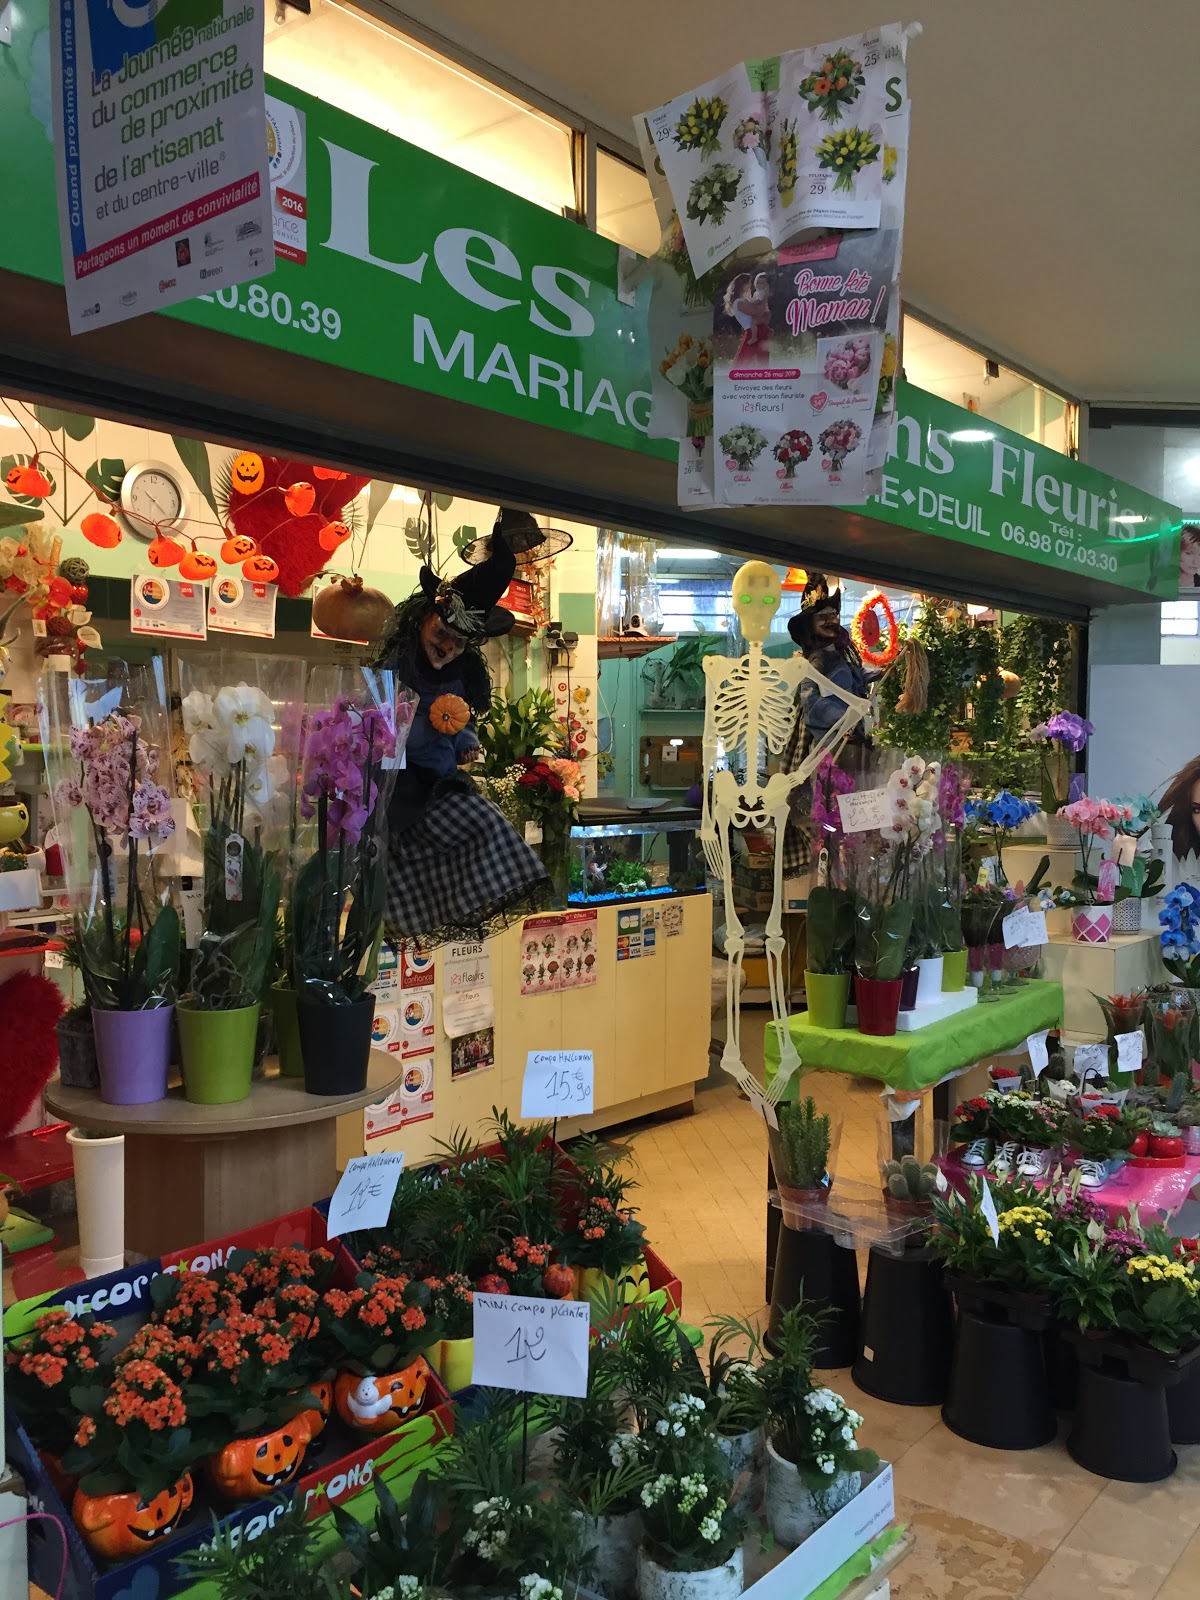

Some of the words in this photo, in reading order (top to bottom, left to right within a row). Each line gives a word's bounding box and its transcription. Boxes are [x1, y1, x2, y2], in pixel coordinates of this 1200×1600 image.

[63, 17, 73, 60] rime
[91, 69, 111, 97] La
[118, 26, 194, 84] Journée
[197, 5, 254, 45] nationale
[92, 100, 116, 129] du
[121, 44, 238, 115] commerce
[120, 115, 146, 145] de
[150, 62, 254, 138] proximité
[64, 67, 79, 157] proximité
[94, 164, 118, 194] de
[122, 116, 225, 182] l'artisanat
[68, 164, 81, 227] Quand
[96, 201, 110, 220] et
[112, 192, 129, 214] du
[281, 196, 304, 213] 2016
[76, 242, 125, 275] Partageons
[127, 236, 139, 250] un
[141, 216, 180, 243] moment
[181, 209, 195, 225] de
[196, 176, 259, 218] convivialité
[318, 136, 595, 338] Les
[794, 267, 842, 297] Bonne
[196, 284, 342, 340] 0.80.39
[785, 298, 872, 337] Maman
[733, 371, 763, 379] dimanche
[764, 370, 772, 378] 26
[773, 370, 783, 378] mai
[733, 384, 759, 392] Envoyez
[775, 383, 793, 391] fleurs
[757, 392, 780, 400] artisan
[780, 391, 805, 399] fleuriste
[132, 494, 138, 502] 9
[150, 475, 158, 485] 12
[988, 439, 1137, 541] Fleuris
[170, 499, 176, 508] 3
[918, 486, 991, 537] DEUIL
[452, 944, 483, 958] FLEURS
[403, 974, 433, 985] confiance
